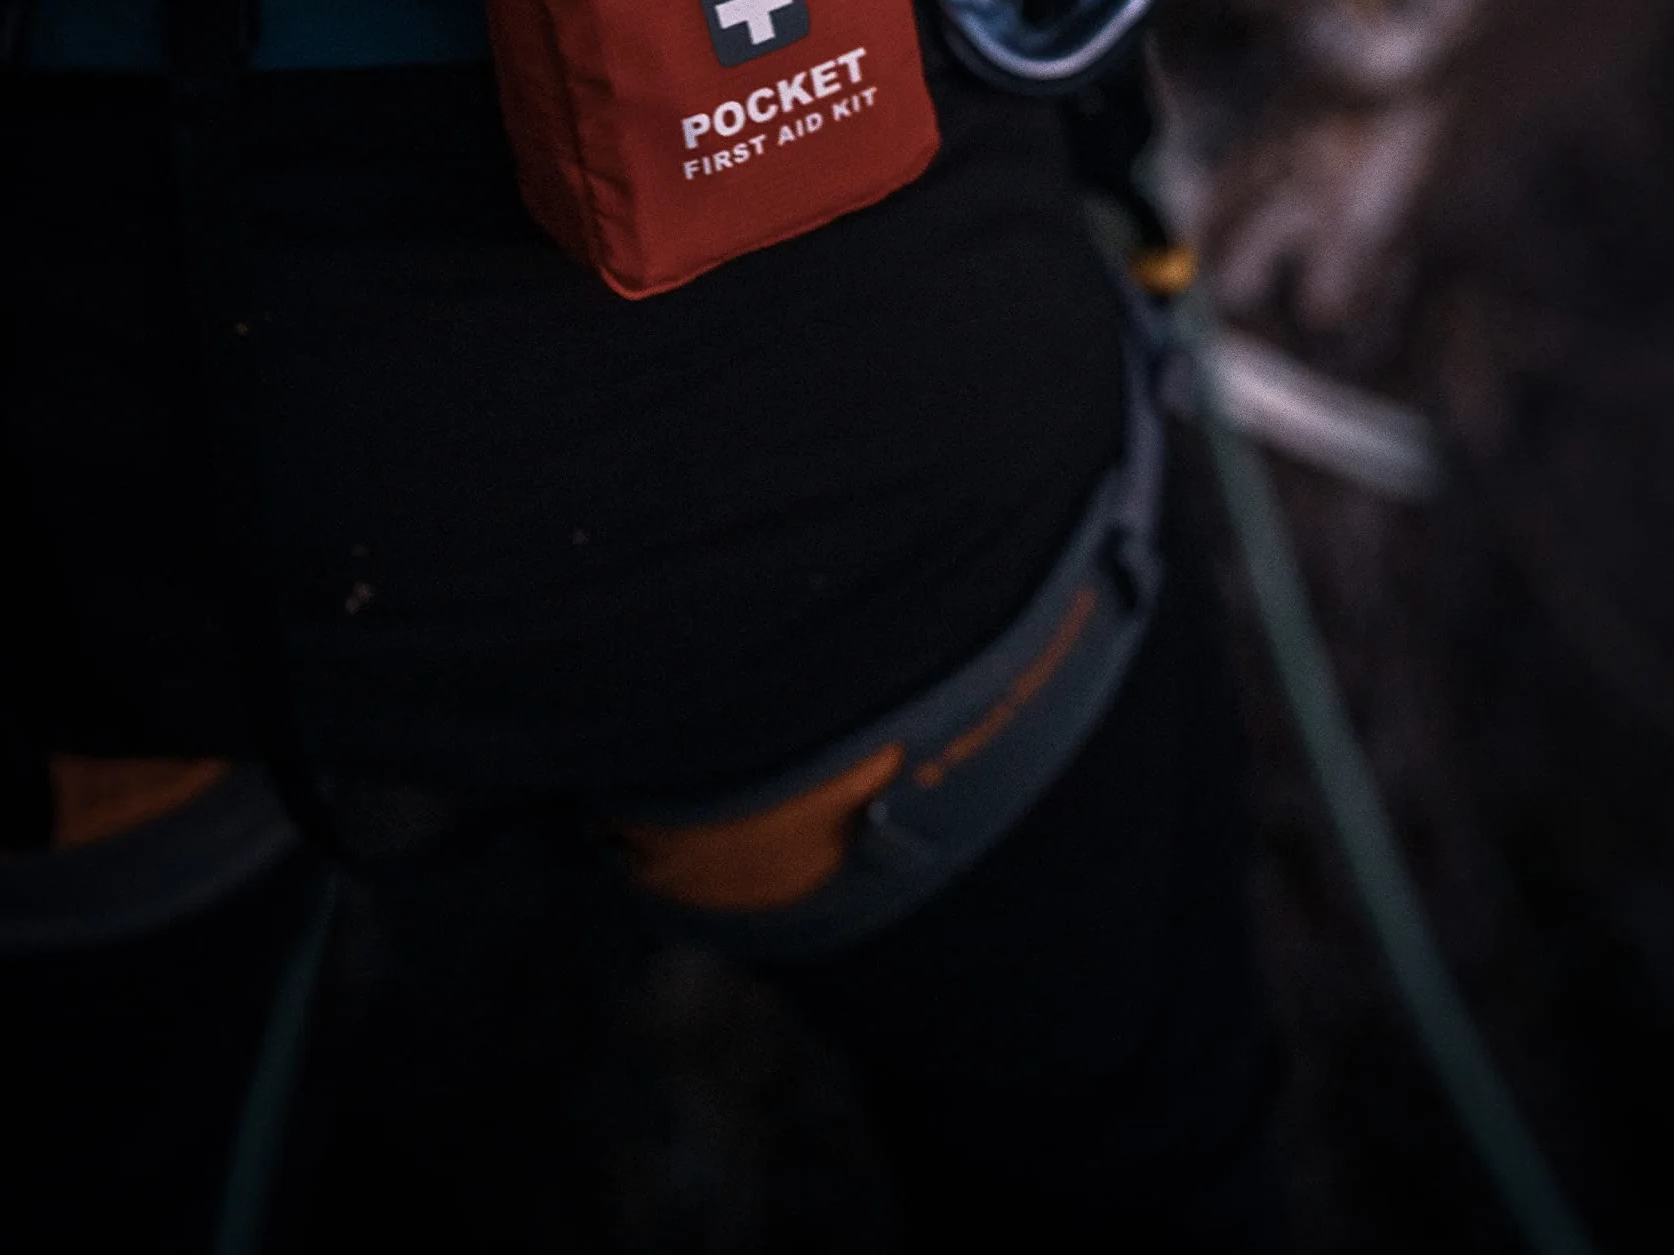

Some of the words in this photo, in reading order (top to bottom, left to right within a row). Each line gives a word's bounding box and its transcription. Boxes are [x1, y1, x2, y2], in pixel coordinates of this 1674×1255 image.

[681, 47, 867, 150] POCKET
[683, 133, 768, 180] FIRST
[777, 111, 824, 146] AID
[831, 86, 878, 122] KIT
